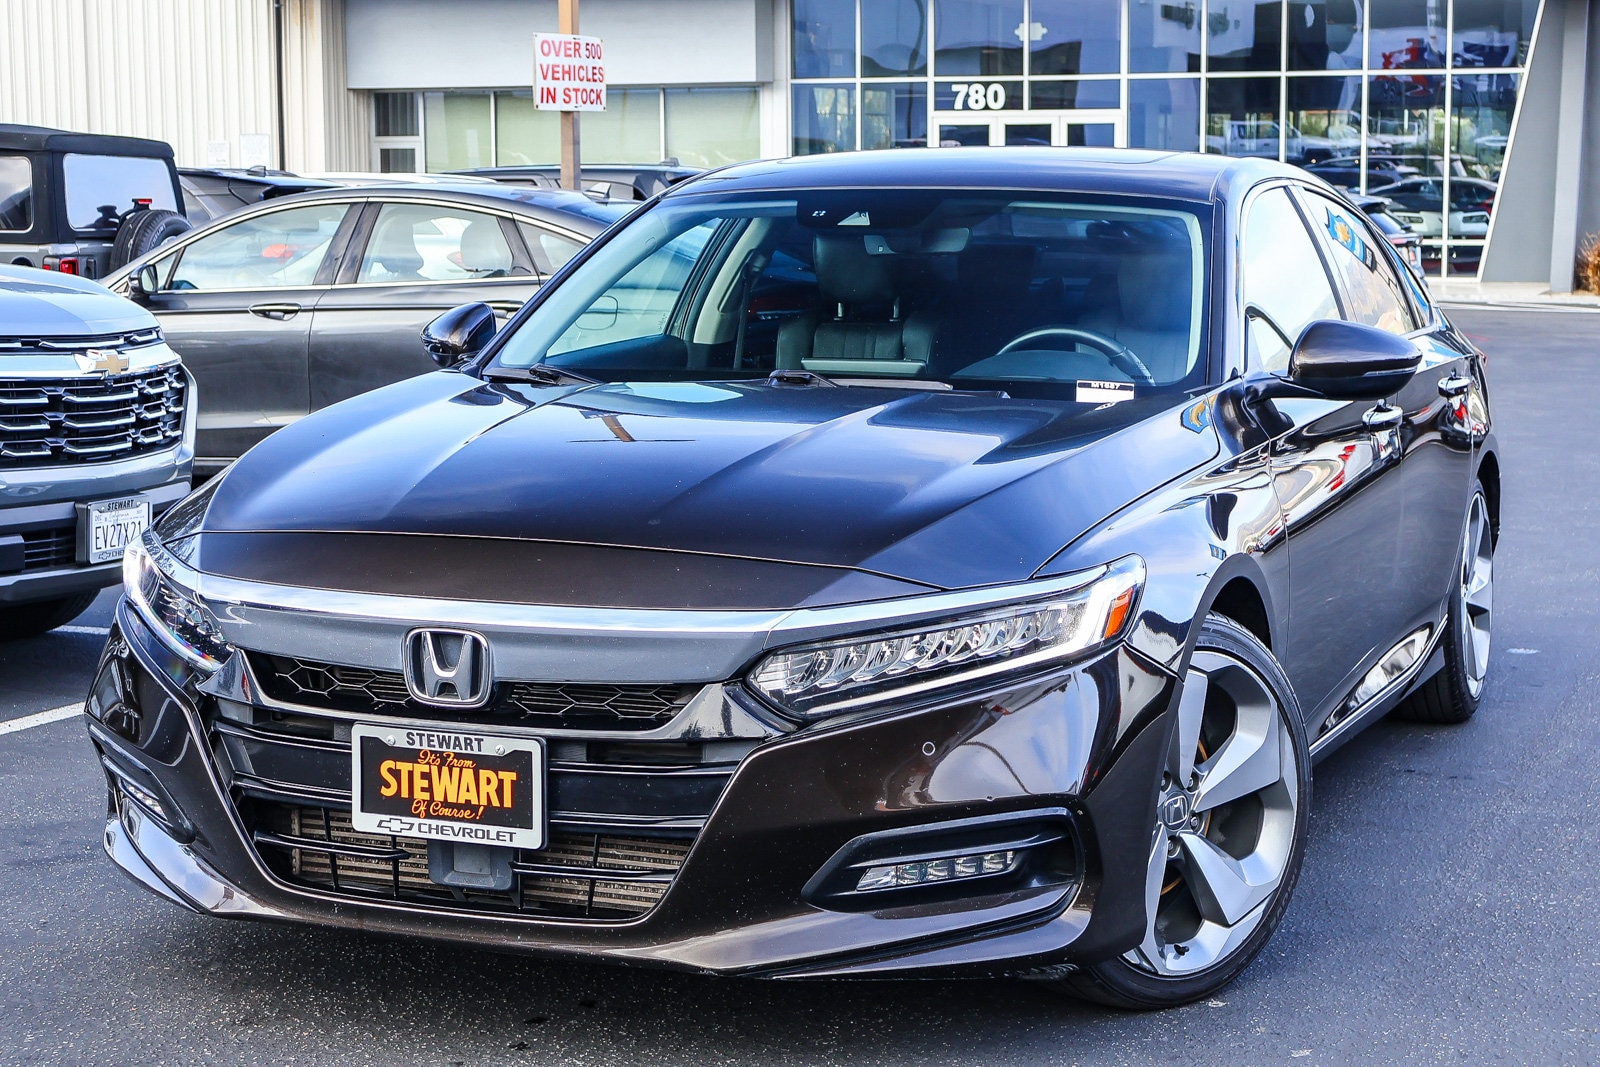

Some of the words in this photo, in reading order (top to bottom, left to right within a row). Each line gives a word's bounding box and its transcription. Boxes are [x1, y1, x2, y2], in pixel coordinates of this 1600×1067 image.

[540, 39, 582, 58] OVER
[585, 42, 602, 60] 500
[540, 63, 604, 83] VEHICLES
[540, 87, 557, 104] IN
[562, 87, 603, 105] STOCK
[951, 83, 1006, 110] 780
[107, 499, 134, 511] STEWART
[406, 731, 484, 752] STEWART
[417, 749, 441, 765] It's
[443, 752, 476, 768] From
[379, 759, 518, 809] STEWART
[411, 799, 428, 819] Of
[417, 822, 517, 843] CHEVROLET
